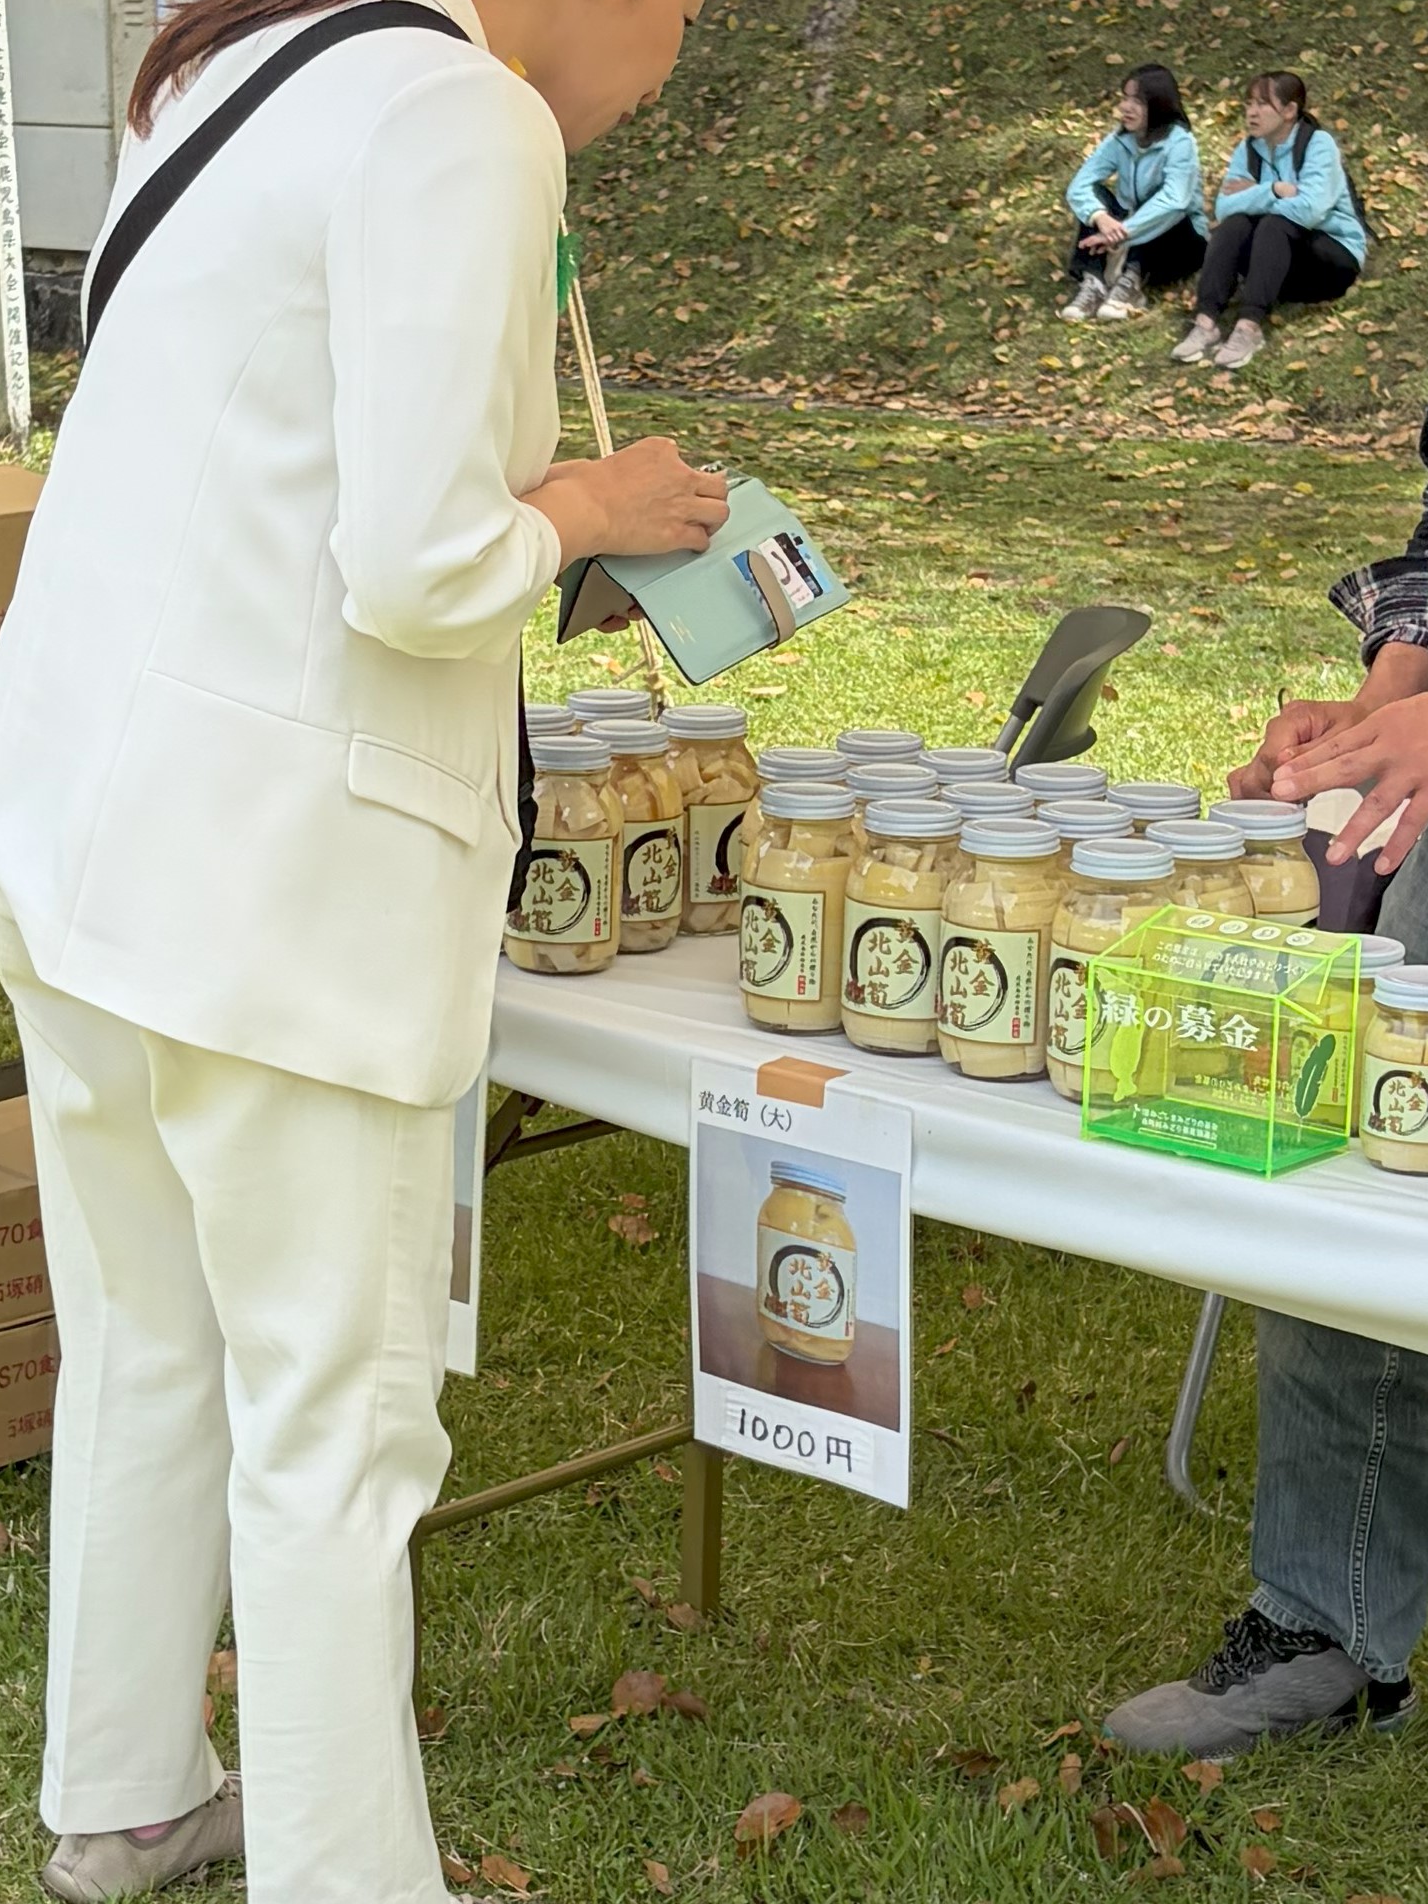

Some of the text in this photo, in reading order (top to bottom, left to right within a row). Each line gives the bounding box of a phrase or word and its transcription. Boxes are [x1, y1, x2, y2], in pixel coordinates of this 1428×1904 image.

[892, 916, 920, 975] 黄金
[1100, 988, 1260, 1053] 緑の募金
[815, 1251, 837, 1302] 黄金
[737, 1406, 854, 1473] 1000円
